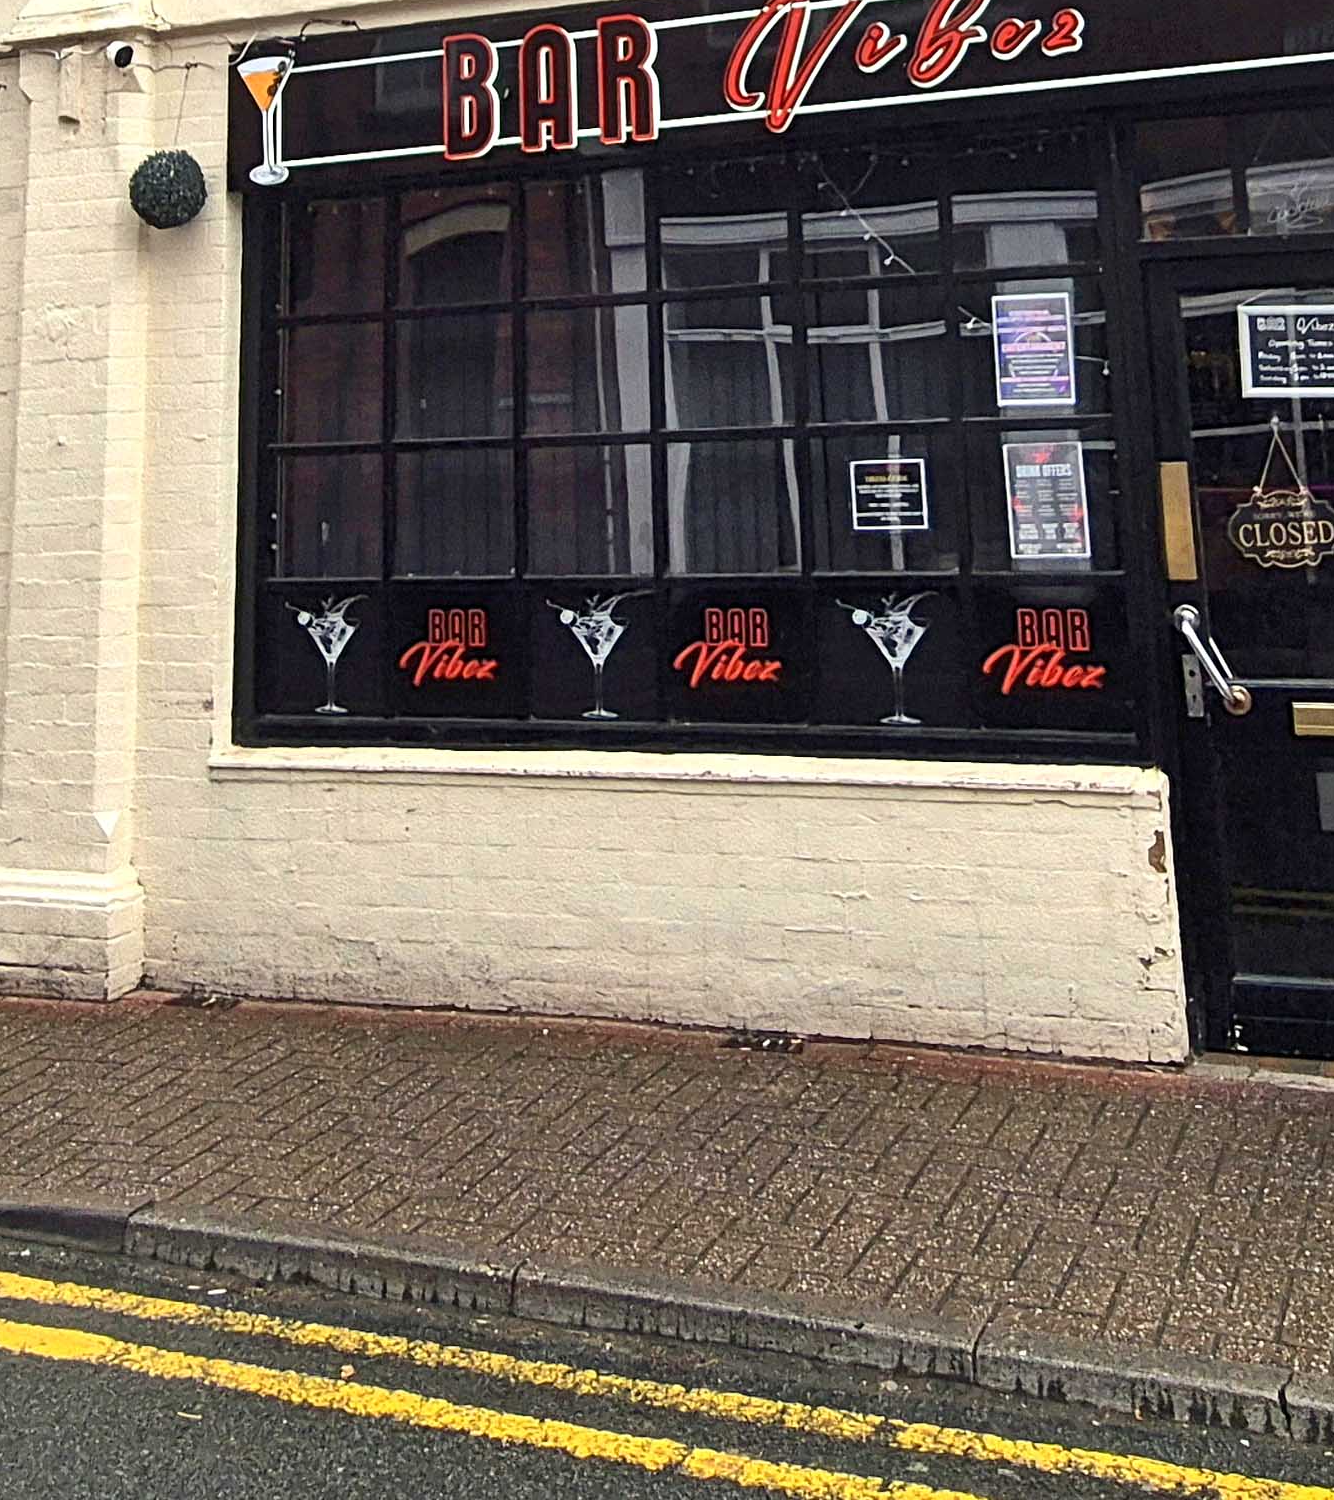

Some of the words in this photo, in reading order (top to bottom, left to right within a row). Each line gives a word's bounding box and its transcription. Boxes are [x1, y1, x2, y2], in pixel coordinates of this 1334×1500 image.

[442, 12, 662, 161] BAR
[428, 609, 487, 647] BAR
[705, 607, 768, 648] BAR
[1017, 608, 1090, 651] BAR
[399, 639, 499, 687] Vibez
[673, 639, 783, 689] Vibez
[982, 643, 1106, 694] Vibez
